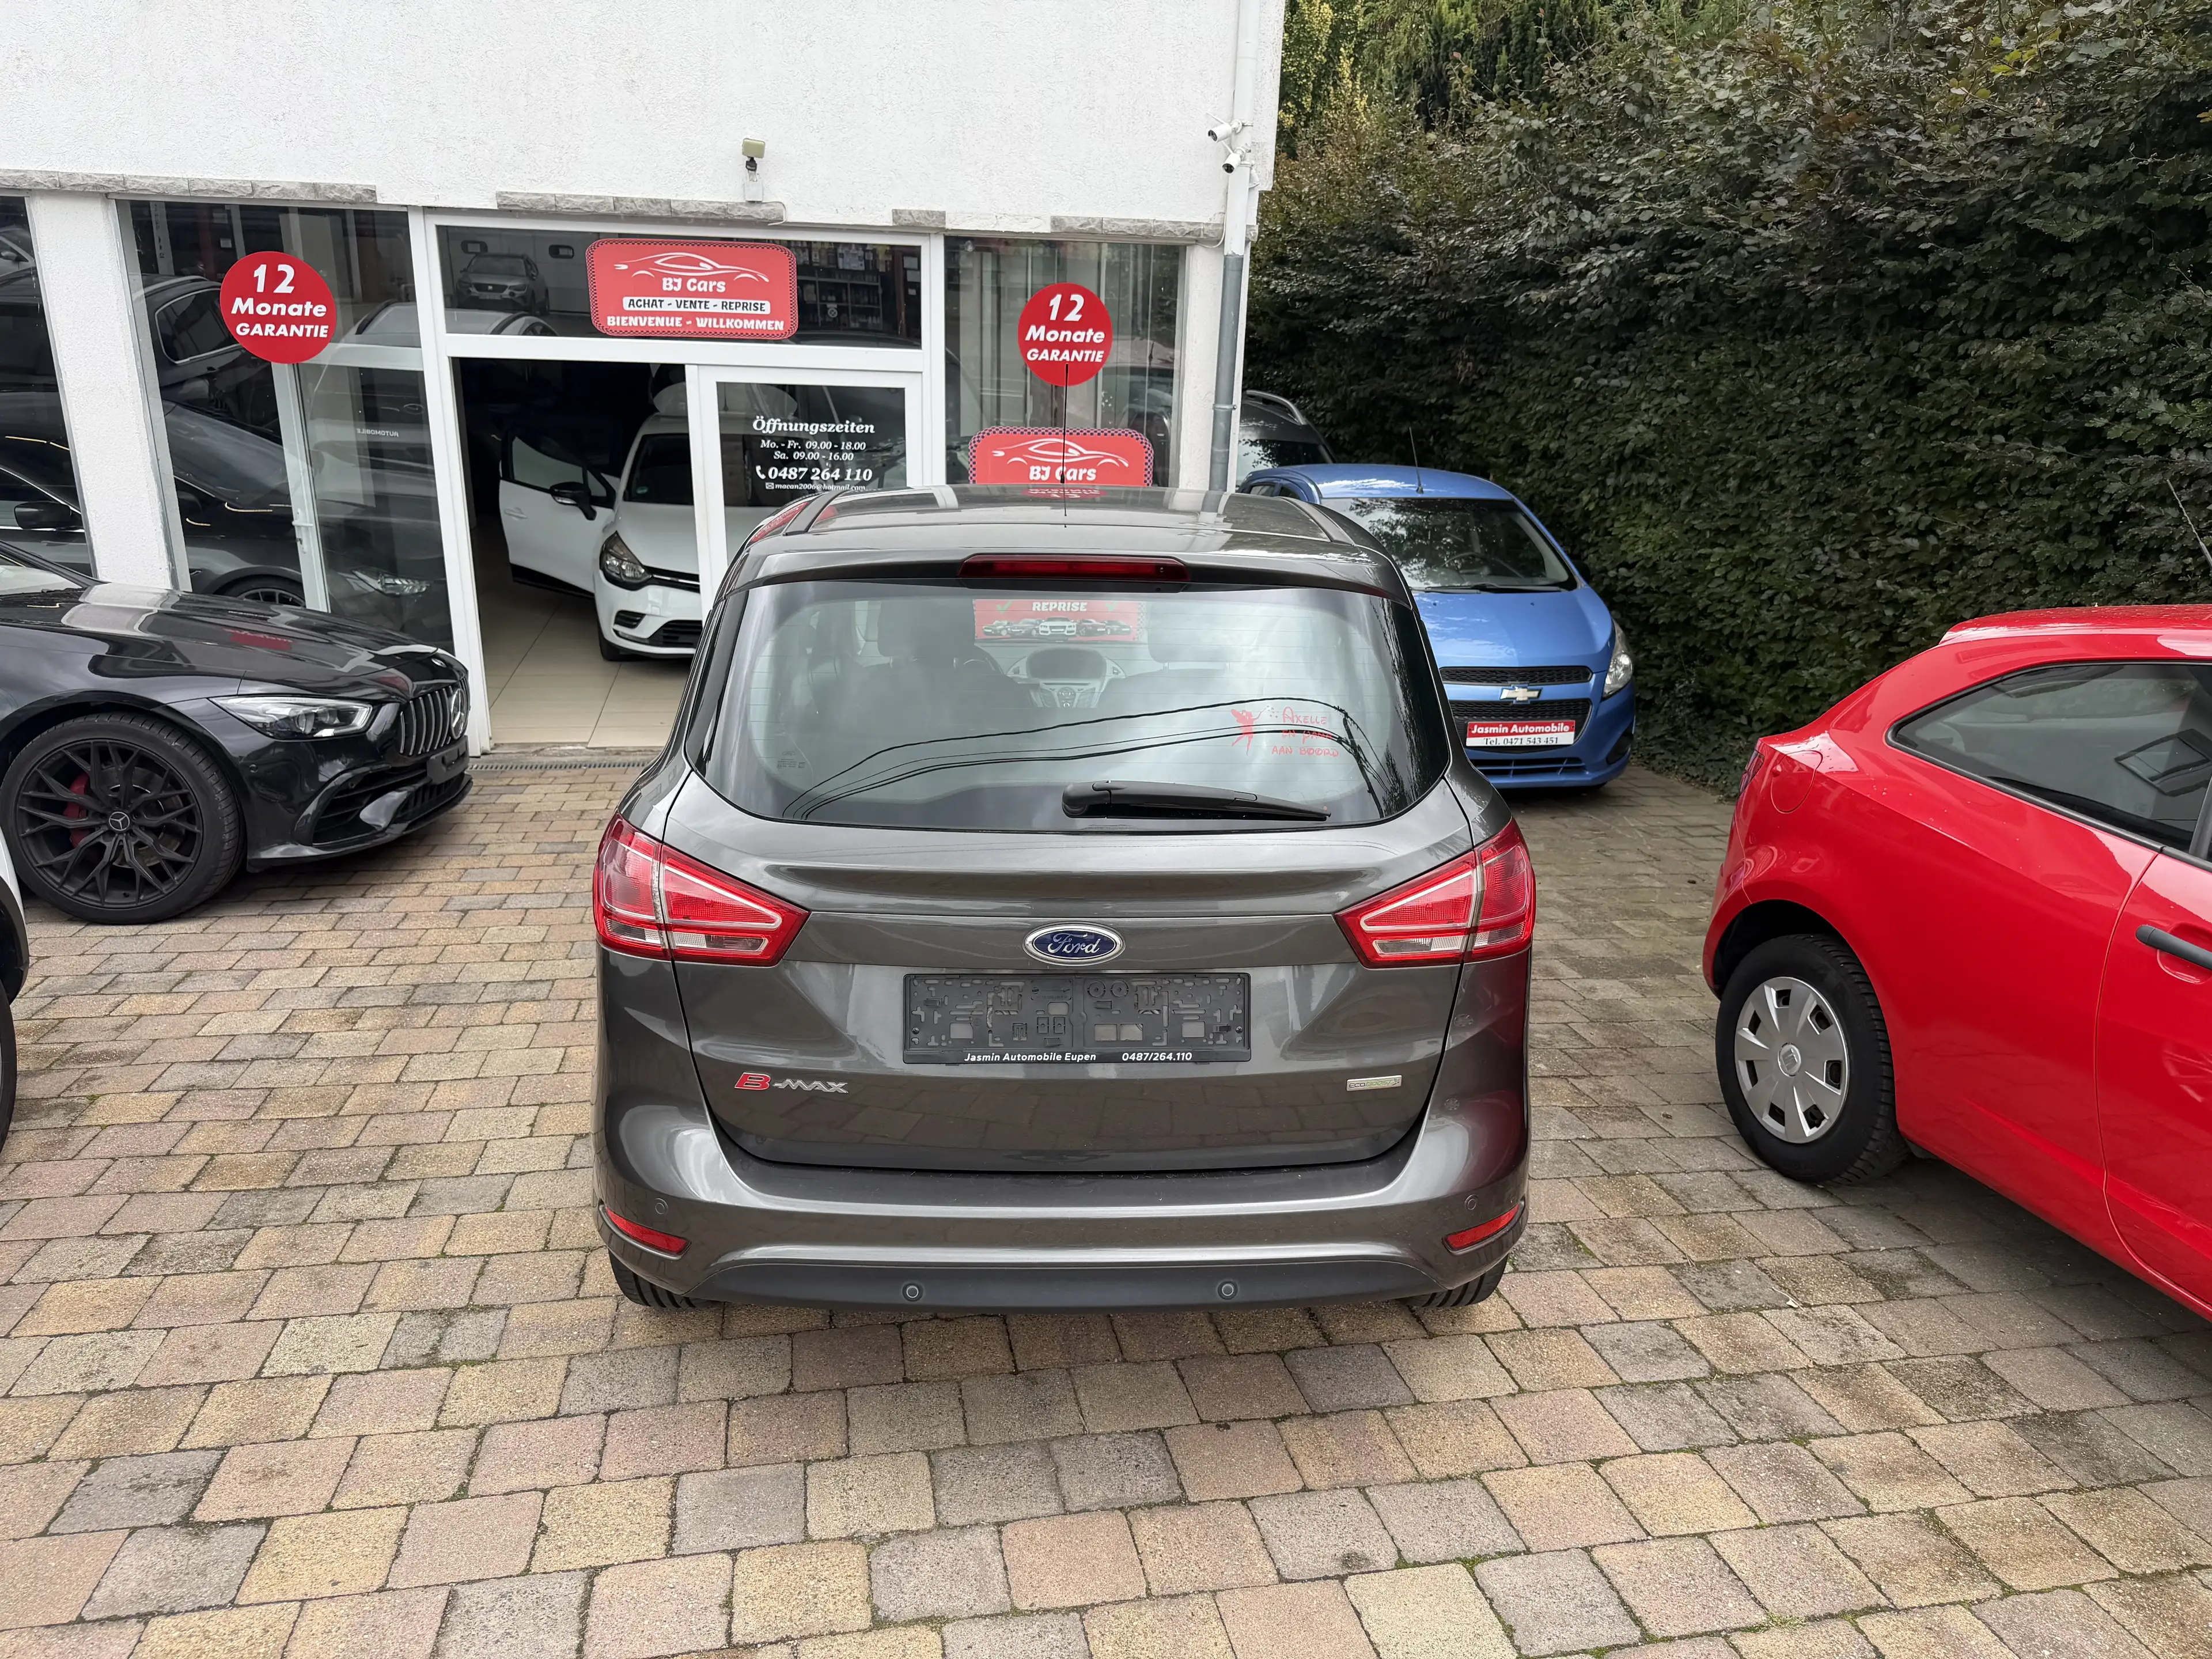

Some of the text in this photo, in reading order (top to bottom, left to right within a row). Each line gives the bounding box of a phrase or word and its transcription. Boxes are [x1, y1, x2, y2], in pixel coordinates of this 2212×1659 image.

[253, 264, 295, 294] 12
[662, 278, 726, 293] BJ Cars
[231, 297, 327, 317] Monate
[628, 299, 664, 309] ACHAT
[675, 300, 710, 310] VENTE
[721, 301, 766, 312] REPRISE
[1049, 294, 1085, 321] 12
[236, 323, 329, 338] GARANTIE
[607, 316, 683, 328] BIENVENUE
[696, 317, 785, 331] WILLKOMMEN
[1025, 325, 1105, 343] Monate
[1027, 349, 1104, 362] GARANTIE
[752, 415, 875, 435] Öffnungszeiten
[760, 440, 779, 449] Mo.
[787, 440, 801, 449] Fr.
[805, 441, 832, 450] 09.00
[840, 441, 866, 450] 18.00
[773, 450, 789, 460] Sa.
[793, 451, 820, 460] 09.00
[828, 452, 854, 461] 16.00
[768, 467, 873, 481] 0487 264 110
[1029, 465, 1051, 481] BJ
[1032, 601, 1088, 612] REPRISE
[1471, 722, 1570, 734] Jasmin Automobile
[1271, 745, 1339, 757] AAN BOORD
[1047, 933, 1101, 954] Ford
[964, 1052, 1192, 1062] Jasmin Automobile Eupen 0487/264.110
[734, 1072, 849, 1093] B-MAX
